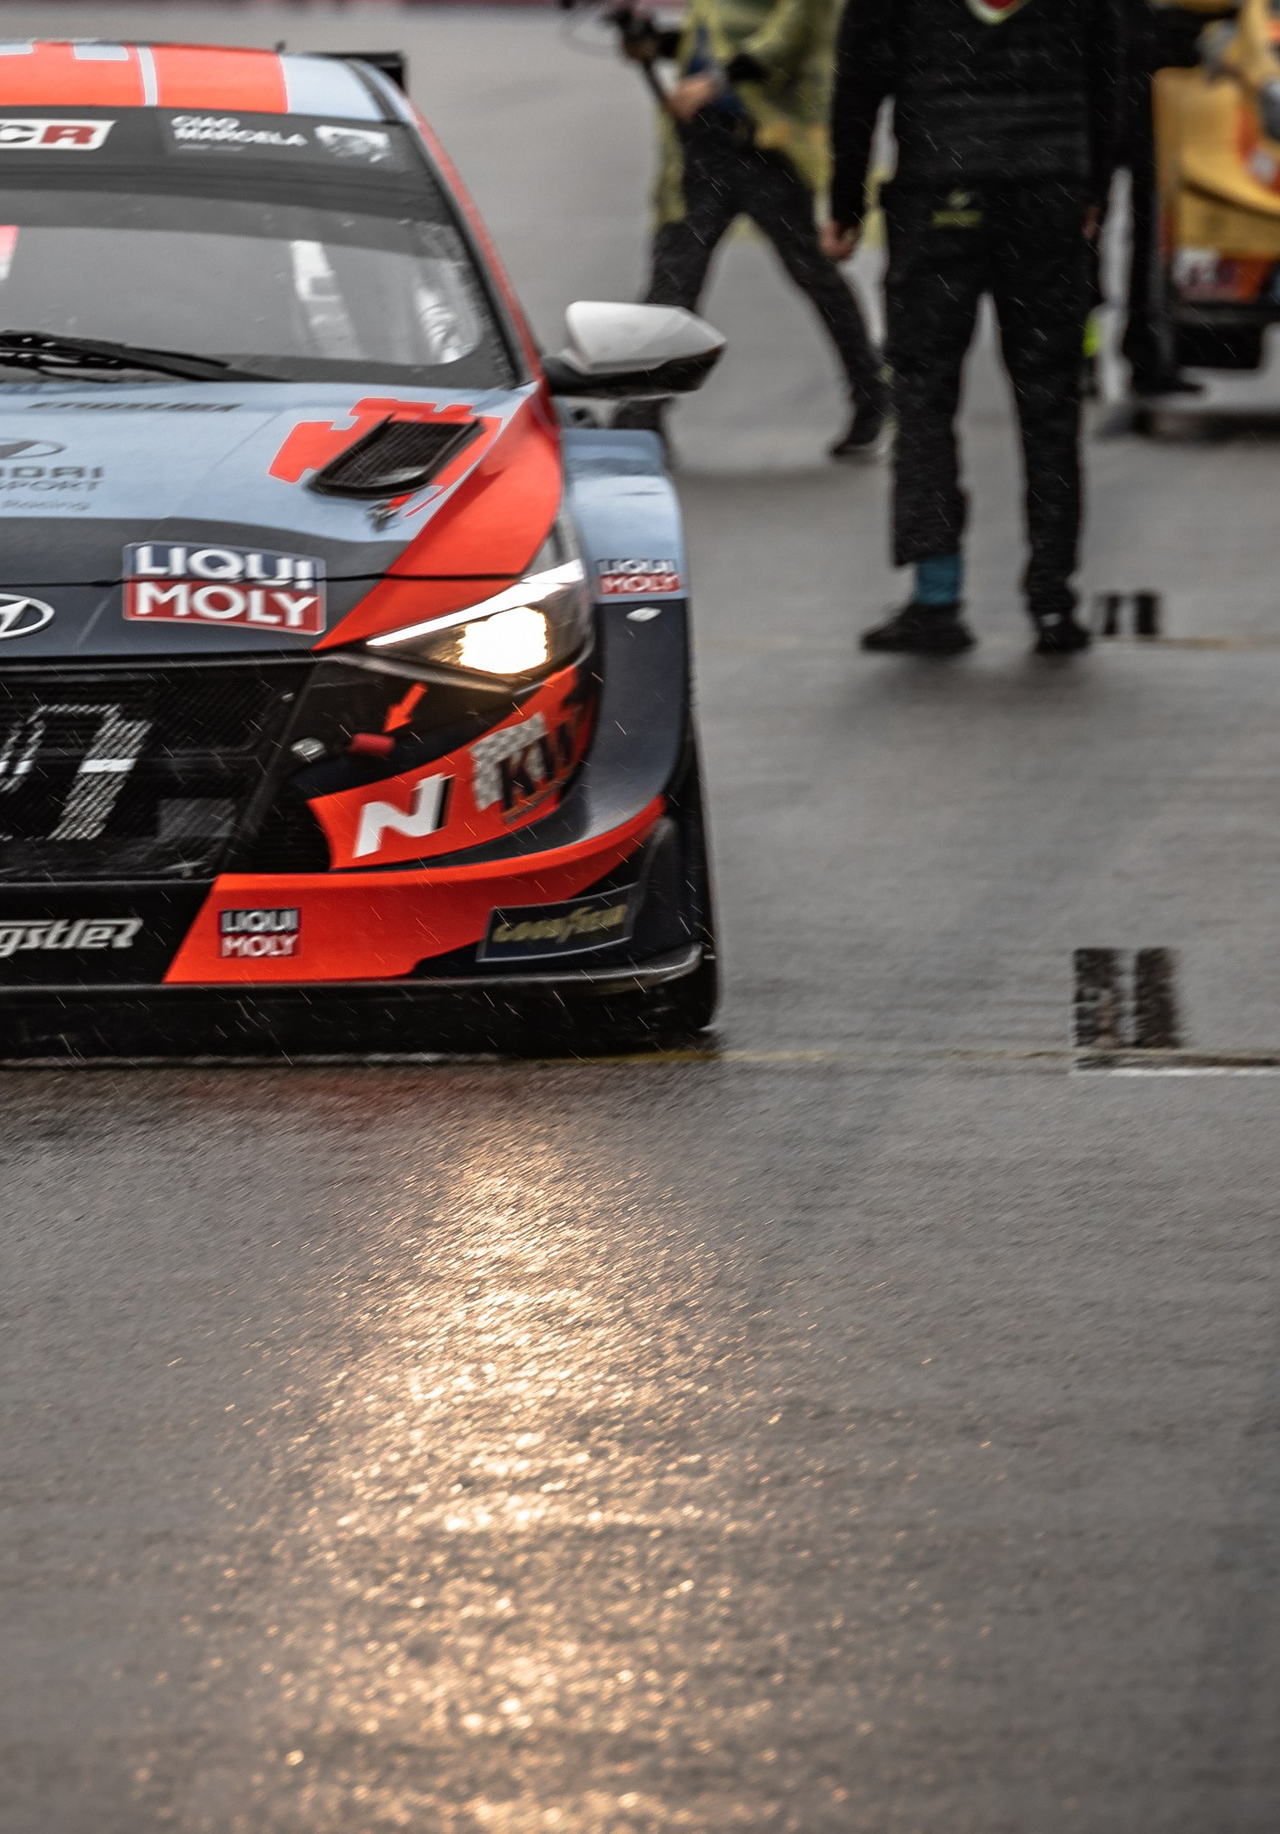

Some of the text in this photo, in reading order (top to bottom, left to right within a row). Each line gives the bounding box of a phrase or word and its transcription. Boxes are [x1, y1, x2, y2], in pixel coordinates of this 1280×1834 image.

[135, 546, 314, 589] LIQUI
[136, 583, 317, 627] MOLY
[222, 910, 297, 932] LIQUI
[222, 935, 299, 957] MOLY
